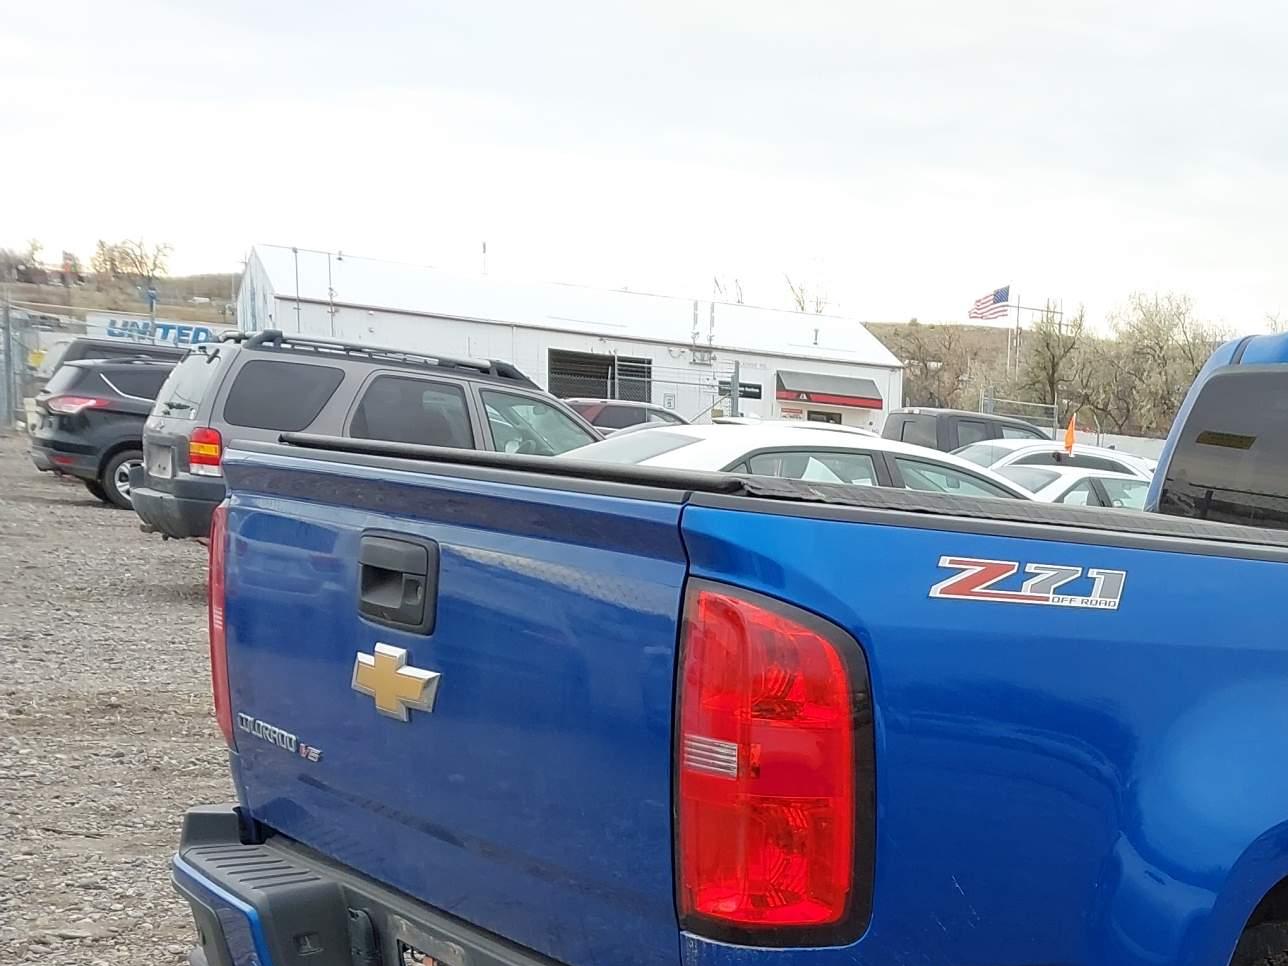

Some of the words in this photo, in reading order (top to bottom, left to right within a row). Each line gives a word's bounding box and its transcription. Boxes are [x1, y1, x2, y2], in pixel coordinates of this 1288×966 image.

[929, 555, 1127, 606] Z71
[1051, 596, 1078, 604] OFF
[1080, 598, 1117, 607] ROAD
[237, 712, 297, 752] COLORADO
